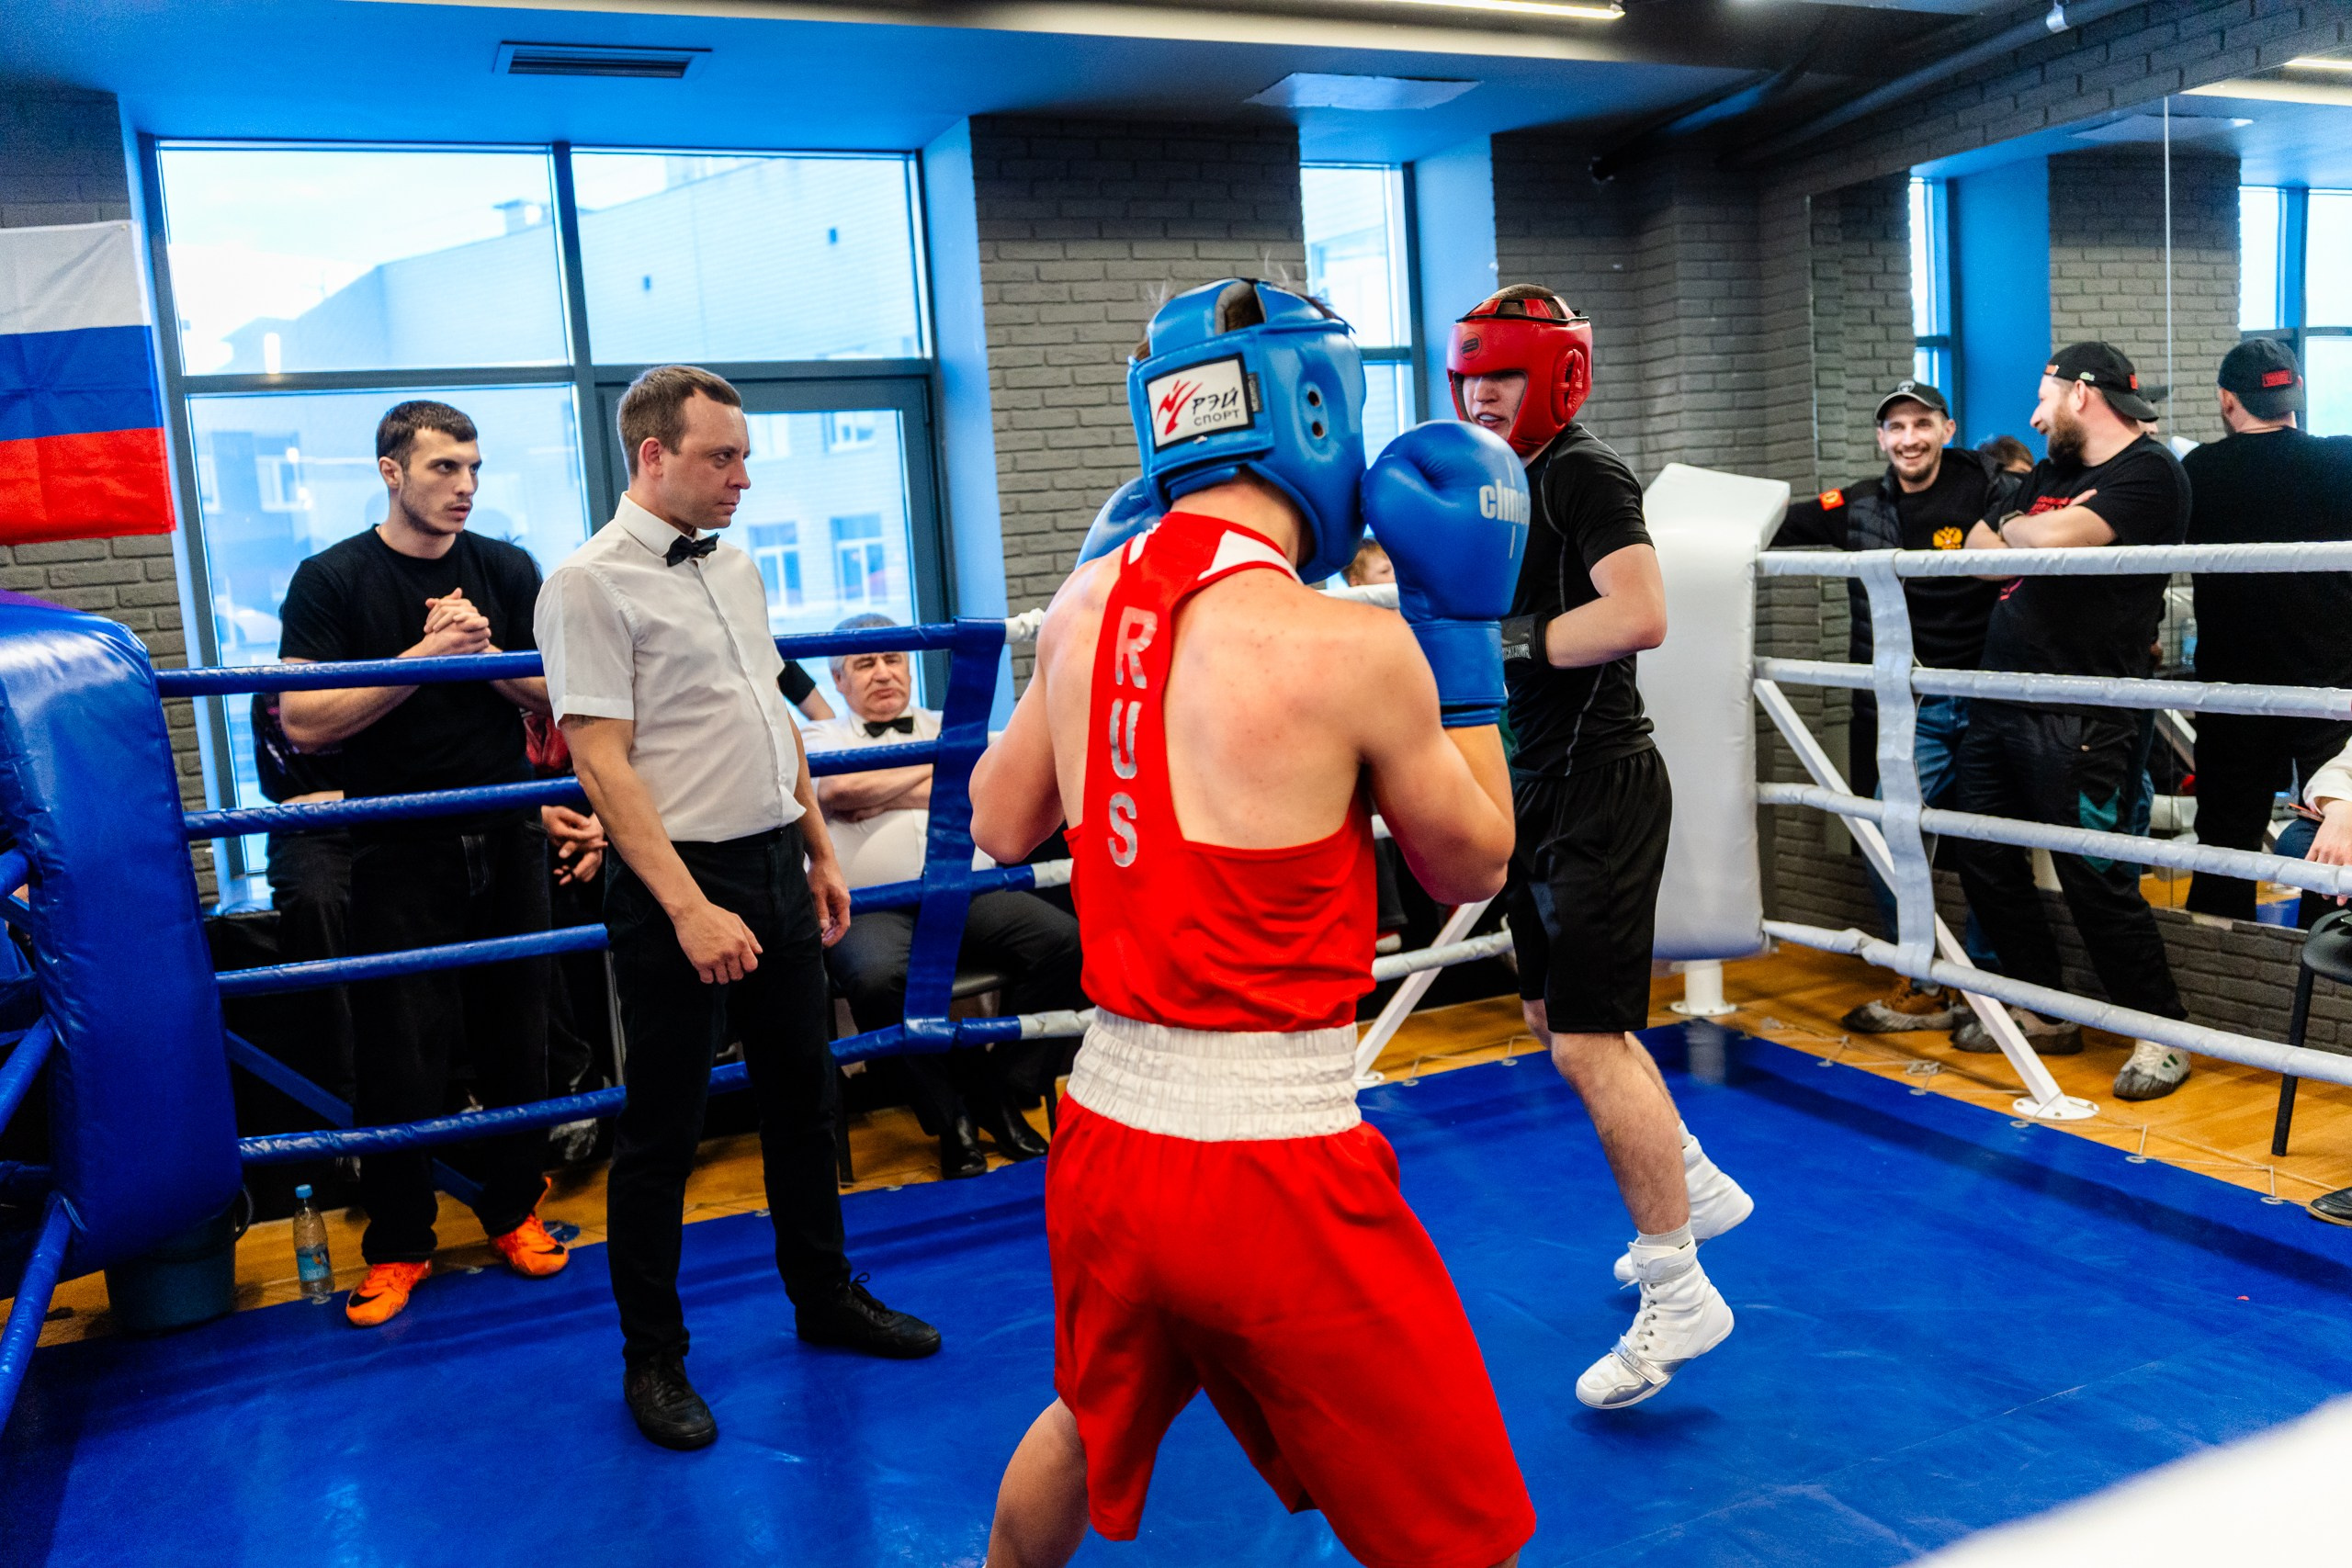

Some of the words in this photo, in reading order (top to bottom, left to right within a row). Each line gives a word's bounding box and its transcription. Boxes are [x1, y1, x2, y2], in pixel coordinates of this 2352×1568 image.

[1193, 387, 1238, 415] РЭЙ
[1193, 409, 1239, 426] СПОРТ
[1107, 605, 1158, 867] RUS
[1621, 1348, 1641, 1368] MAD
